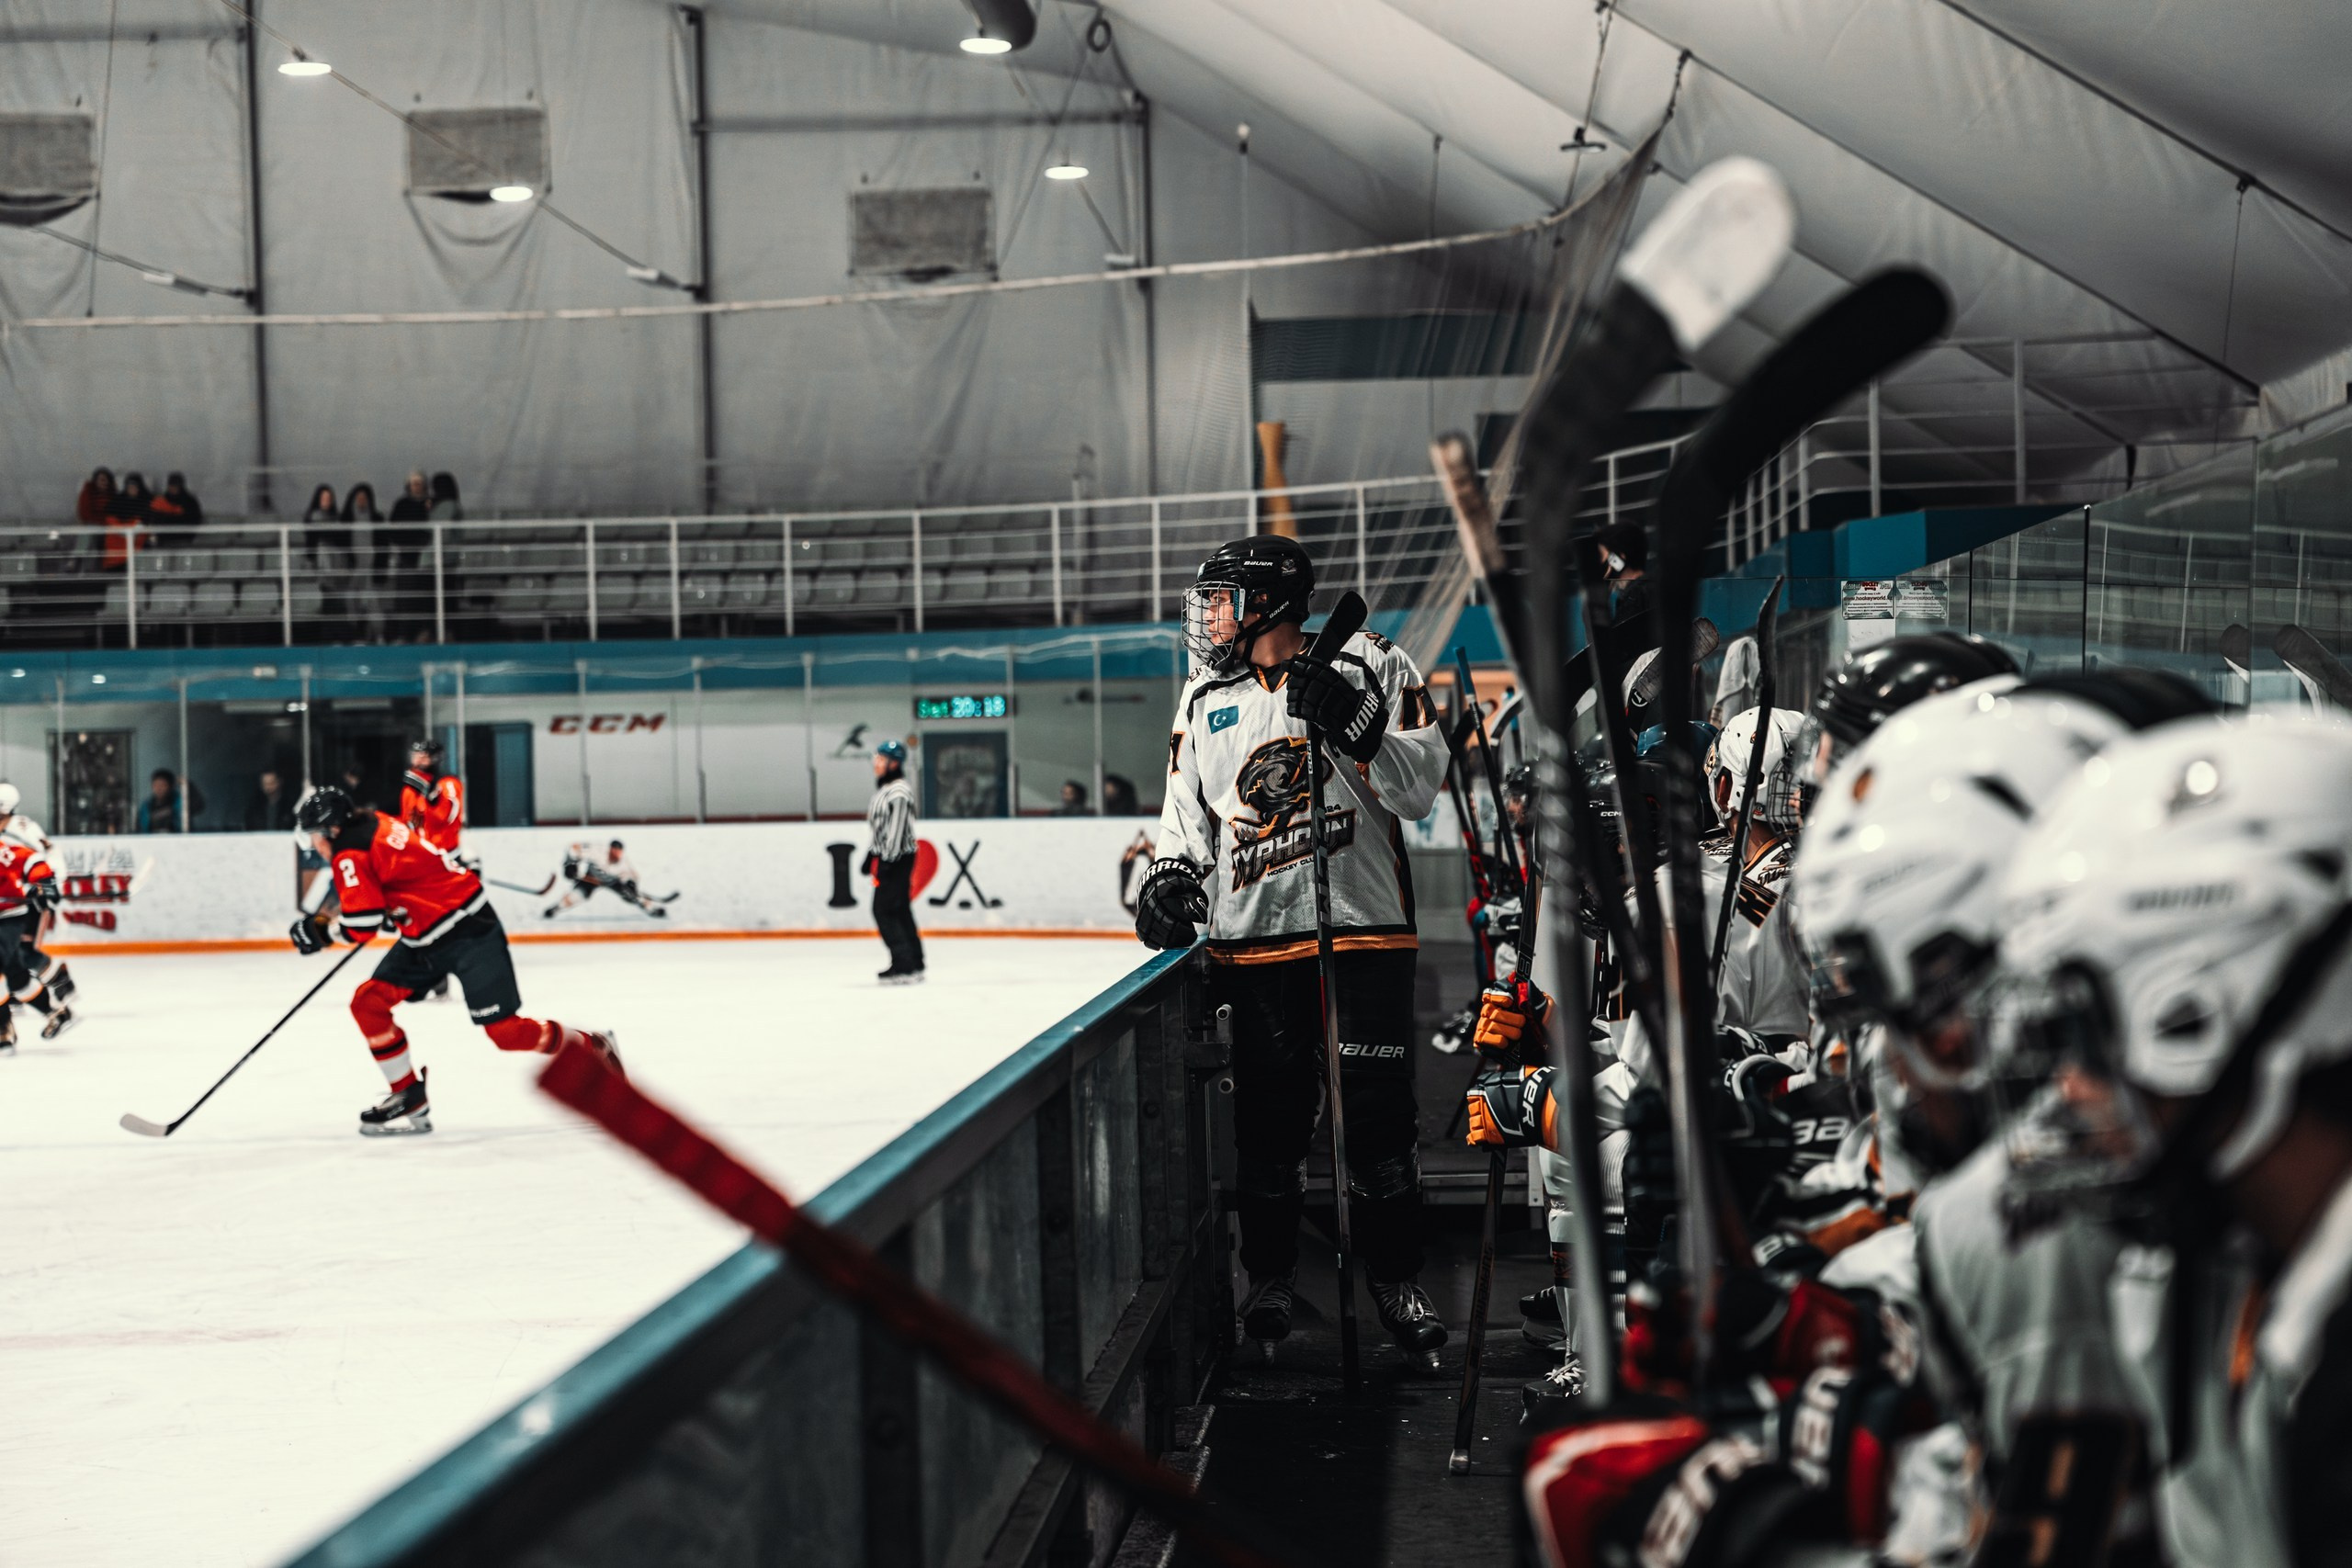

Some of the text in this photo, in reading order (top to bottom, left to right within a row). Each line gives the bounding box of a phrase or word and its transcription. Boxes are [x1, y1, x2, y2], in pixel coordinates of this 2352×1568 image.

[549, 713, 666, 735] CCM
[1231, 810, 1355, 894] TYPHON
[338, 858, 359, 888] 2
[1267, 855, 1315, 877] HOCKEY CLU
